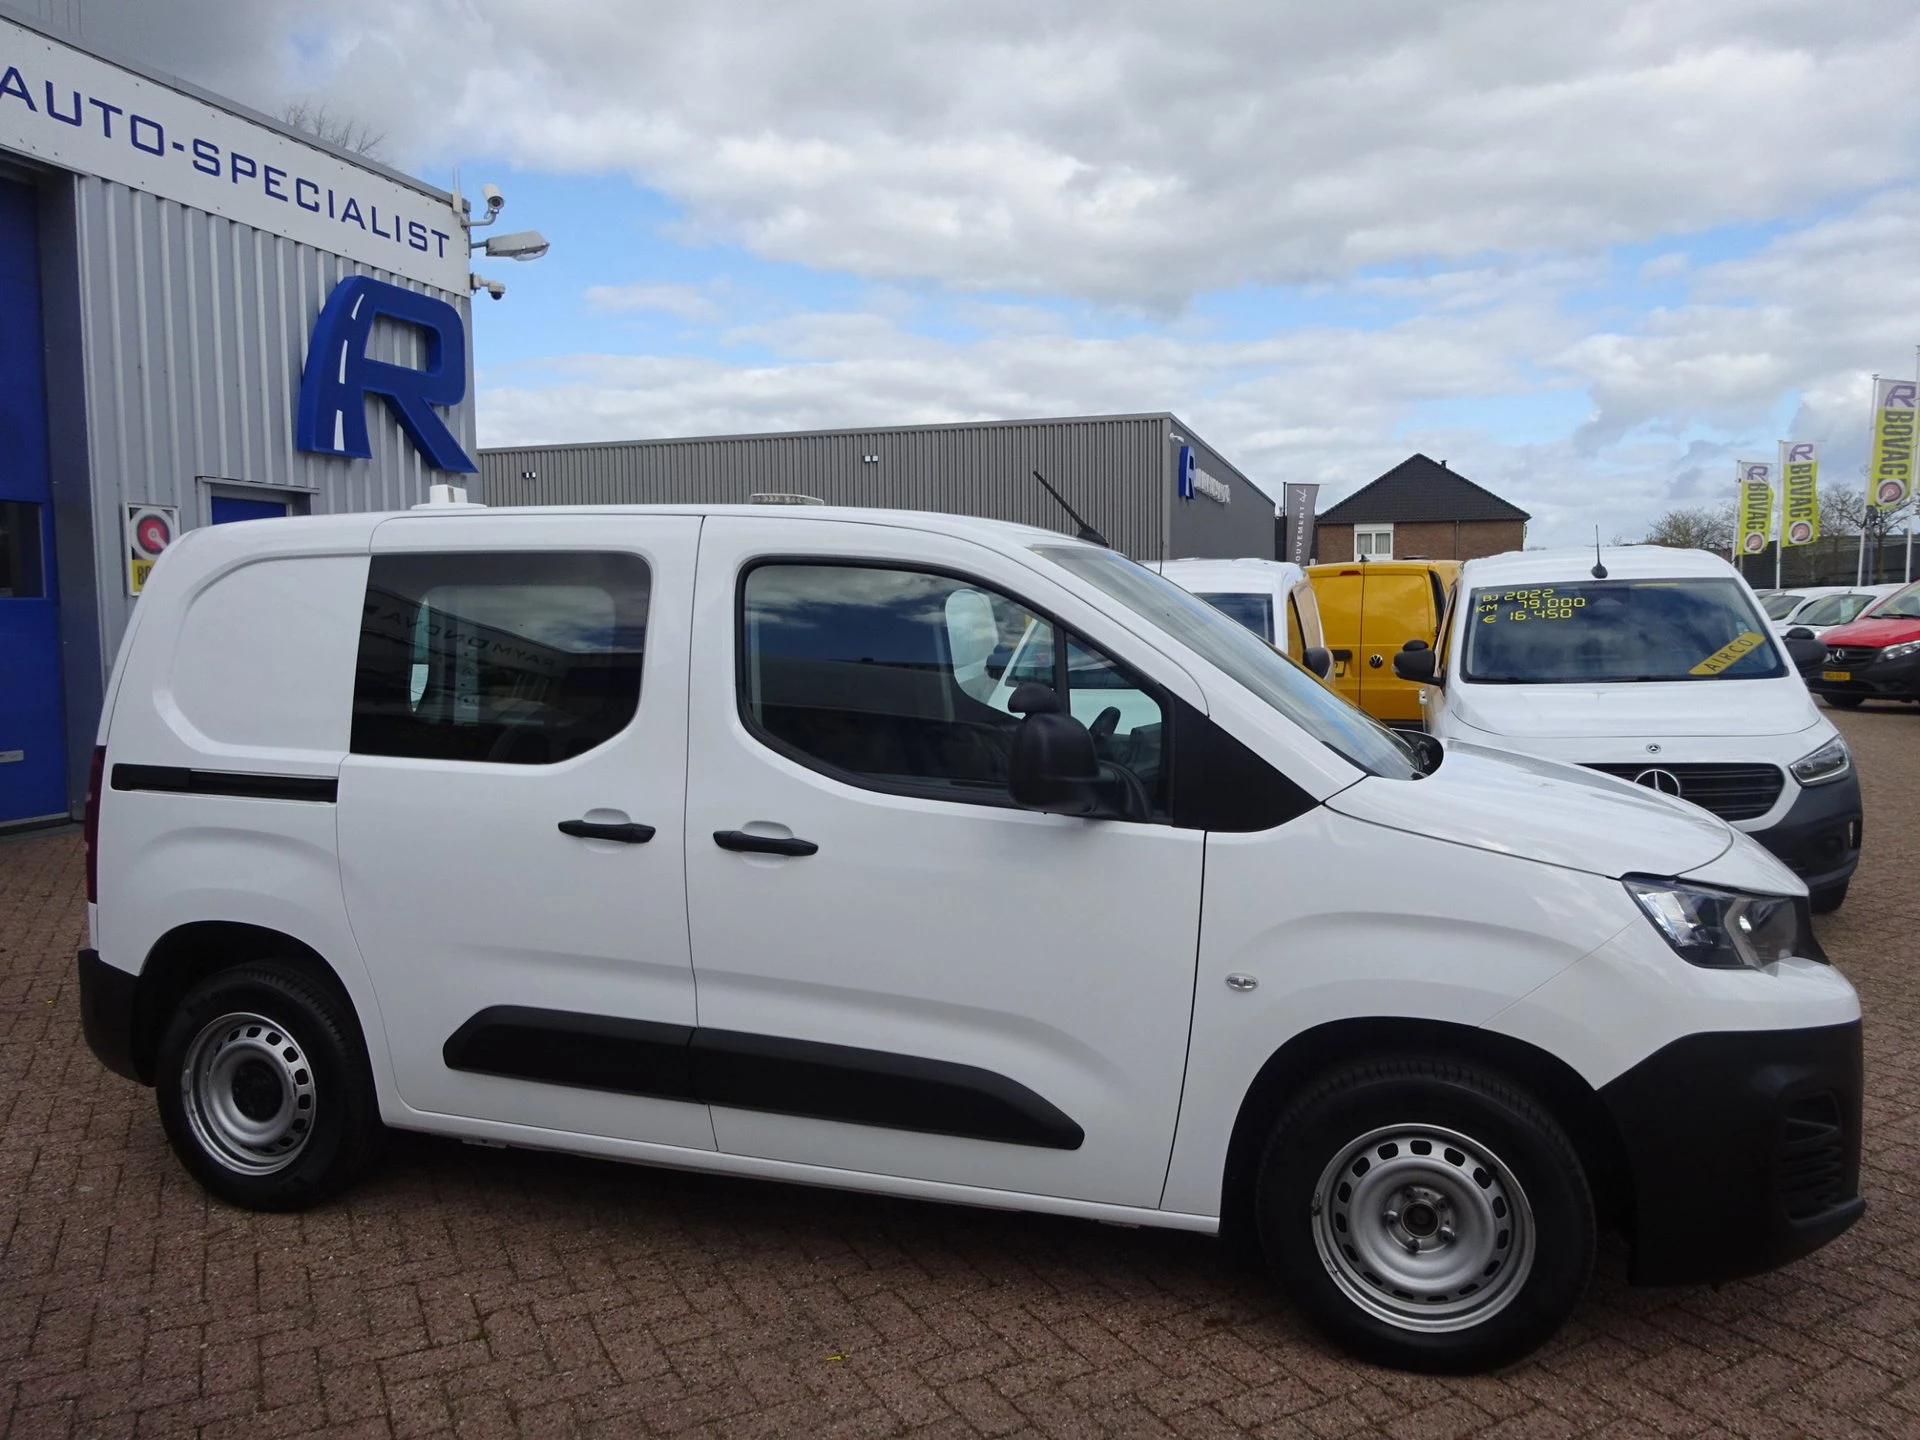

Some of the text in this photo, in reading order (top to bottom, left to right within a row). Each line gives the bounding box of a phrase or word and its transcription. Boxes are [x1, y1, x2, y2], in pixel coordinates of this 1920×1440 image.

[0, 66, 450, 259] AUTO-SPECIALIST
[298, 275, 478, 473] R
[1879, 411, 1914, 475] BOVAG
[1746, 483, 1769, 530] BOVAG
[1789, 463, 1813, 518] BOVAG
[1295, 505, 1305, 565] OUVEMENT
[1475, 597, 1586, 613] KM 79.000
[1482, 608, 1572, 624] € 16.450
[1483, 588, 1554, 602] BJ 2022
[1704, 639, 1754, 672] AIRCO
